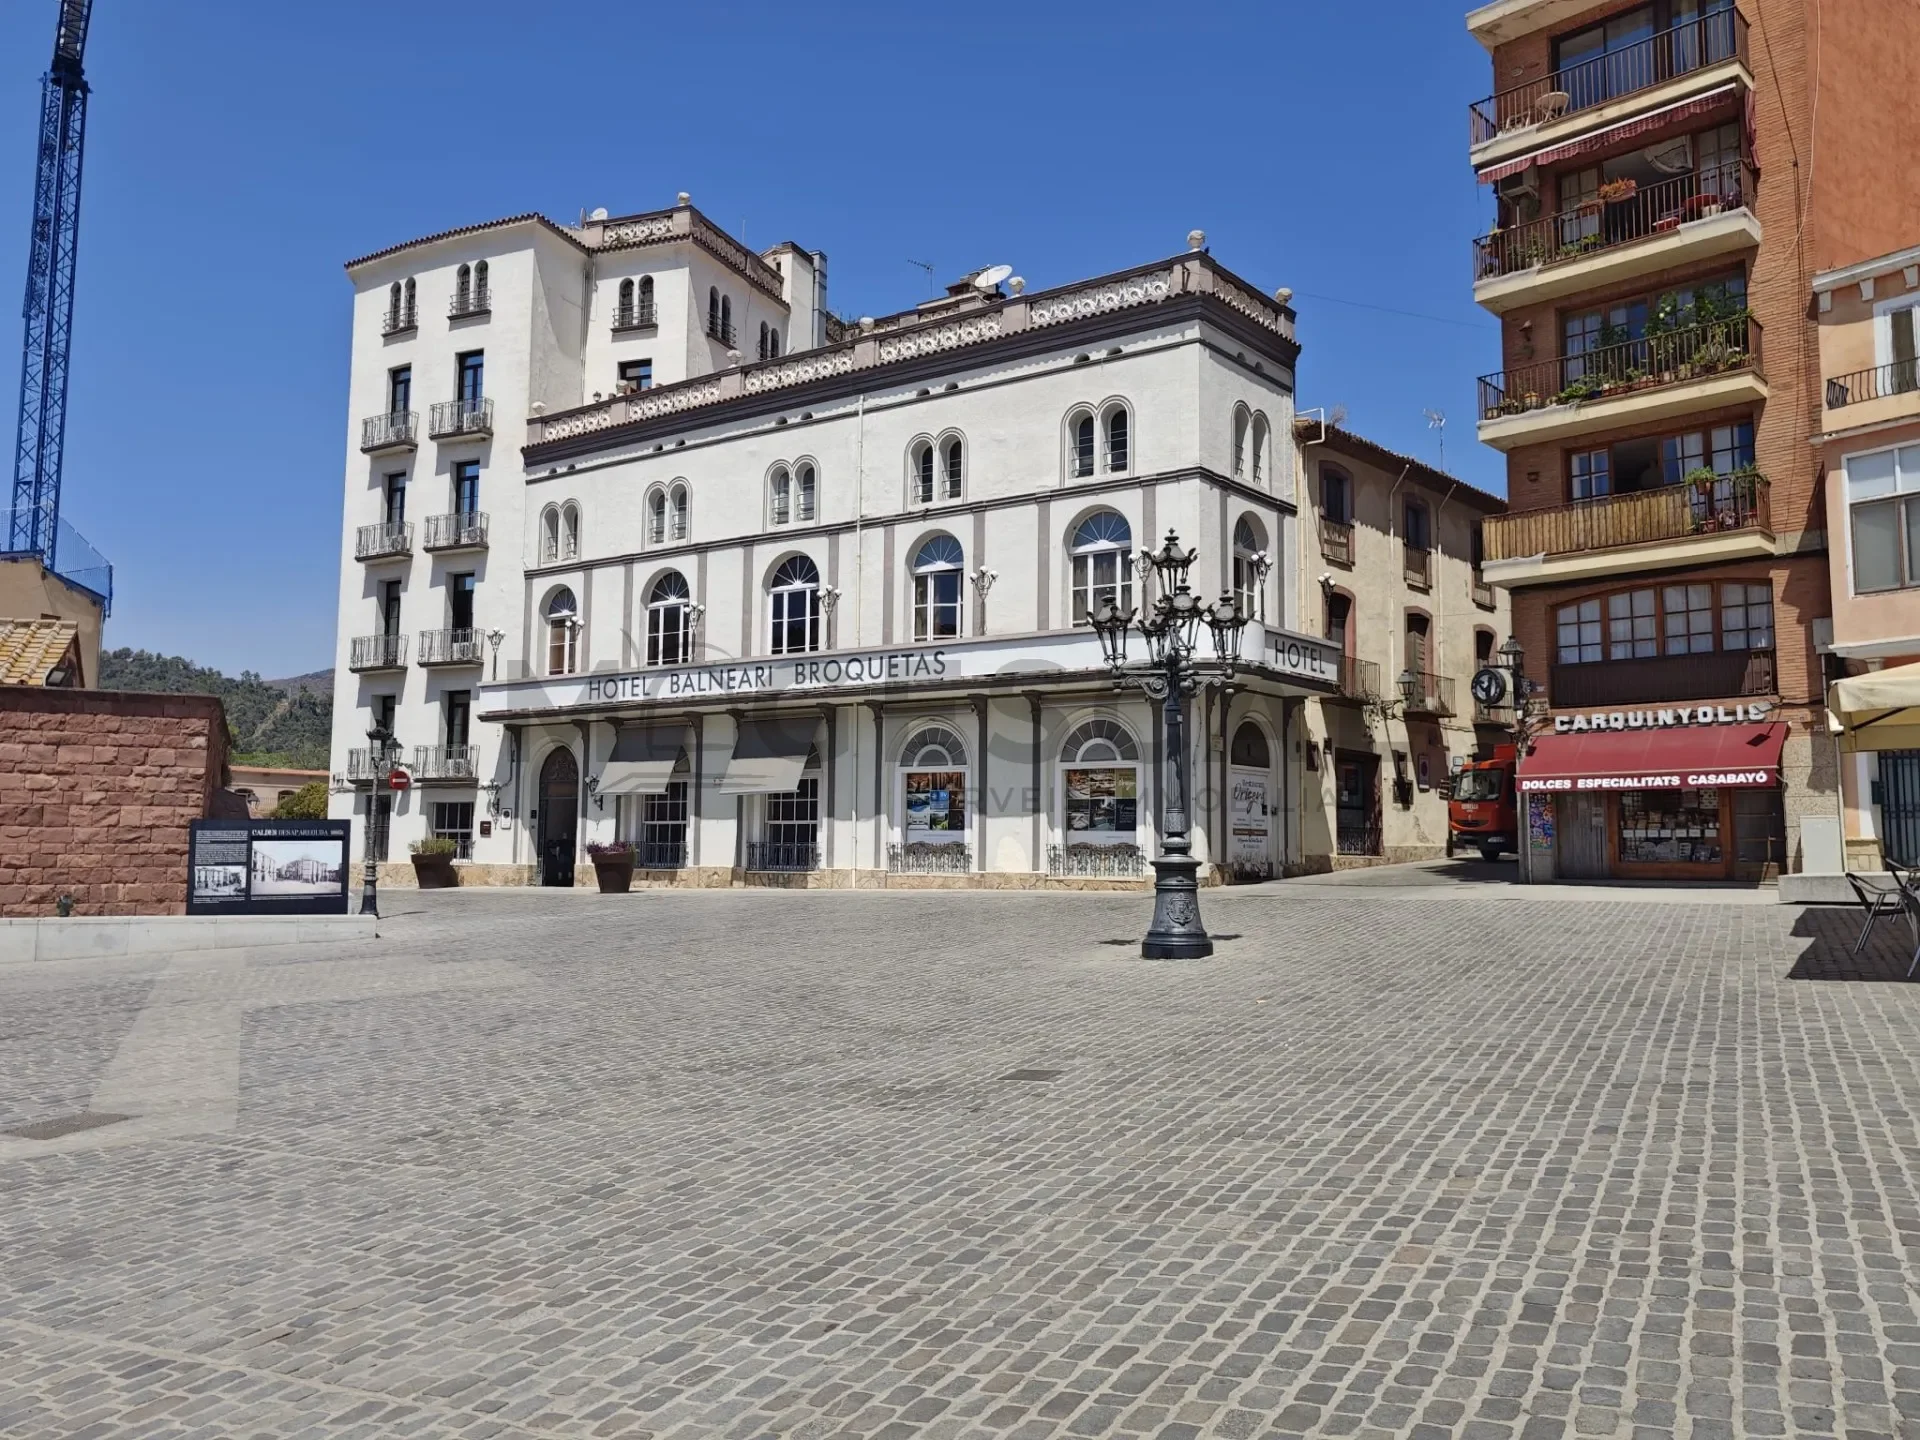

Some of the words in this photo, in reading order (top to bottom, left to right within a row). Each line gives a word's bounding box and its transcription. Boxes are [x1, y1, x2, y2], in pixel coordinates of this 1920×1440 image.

[1274, 638, 1326, 675] HOTEL
[588, 675, 651, 701] HOTEL
[669, 664, 774, 695] BALNEARI
[794, 650, 946, 685] BROQUETAS
[1554, 703, 1768, 733] CARQUINYOLIS
[1521, 777, 1572, 790] DOLCES
[1577, 774, 1681, 789] ESPECIALITATS
[1687, 770, 1768, 786] CASABAYÓ
